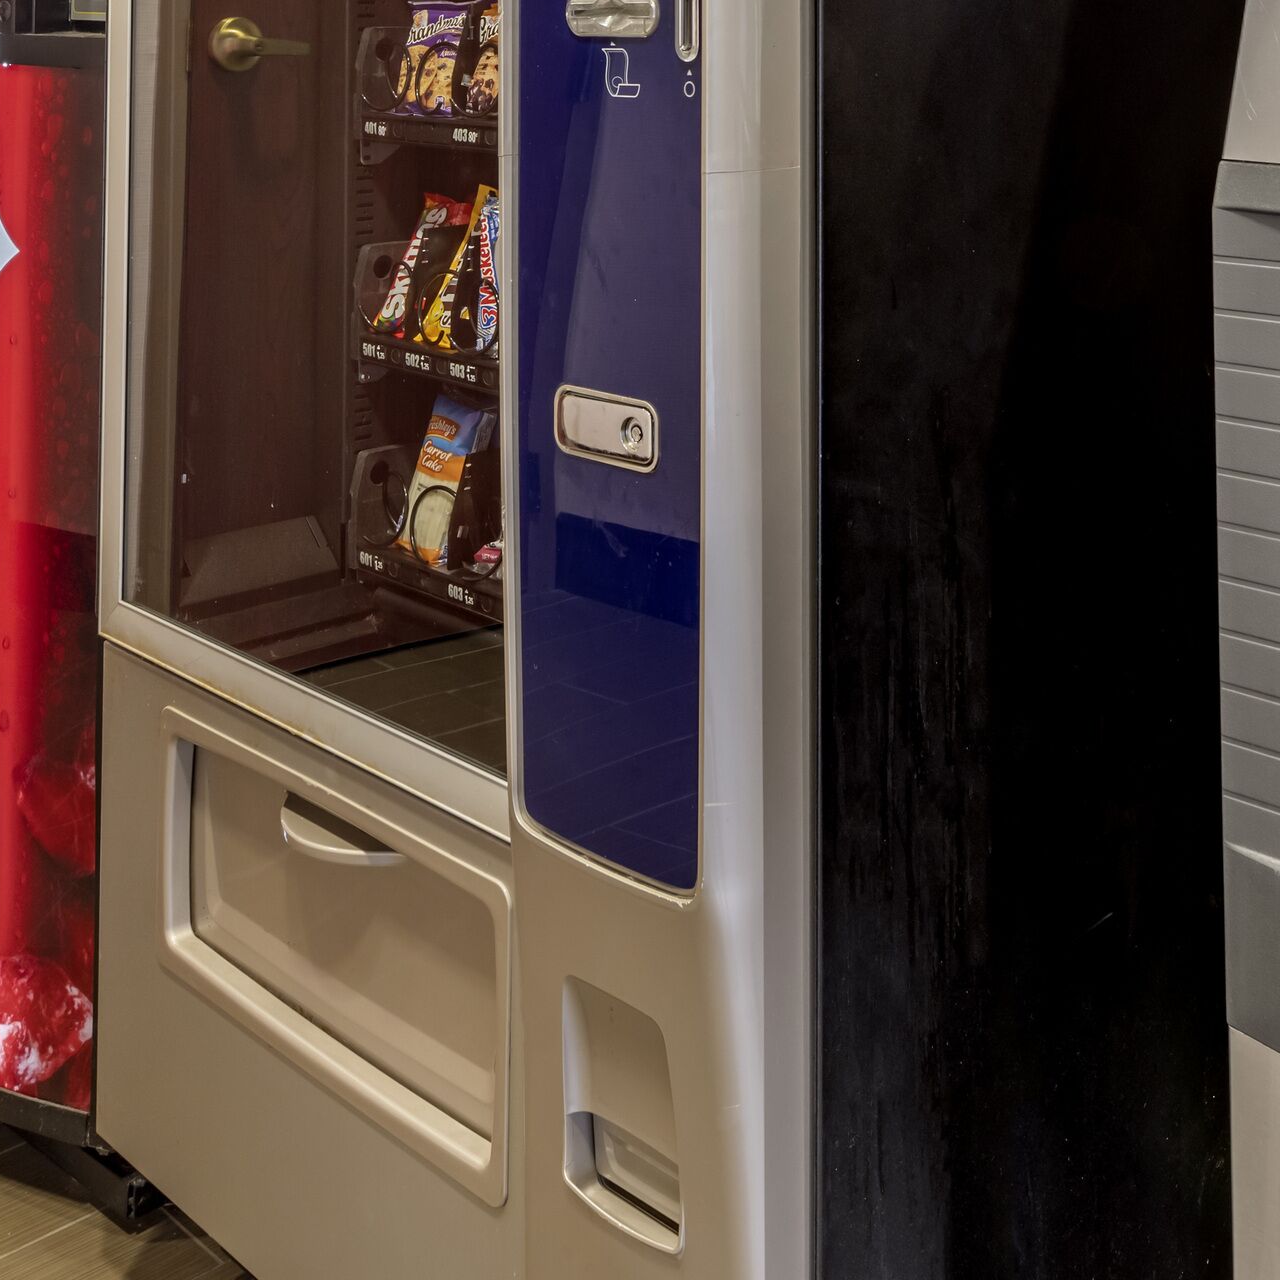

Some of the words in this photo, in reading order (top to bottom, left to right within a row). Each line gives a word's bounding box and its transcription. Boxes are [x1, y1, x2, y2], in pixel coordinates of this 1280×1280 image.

[364, 121, 377, 135] 401
[452, 128, 468, 142] 403
[481, 306, 497, 329] 3
[362, 342, 376, 358] 501
[405, 352, 420, 368] 502
[449, 362, 465, 379] 503
[429, 419, 456, 436] reshley's
[424, 440, 453, 462] Carrot
[422, 454, 443, 472] Cake
[360, 551, 373, 567] 601
[448, 583, 463, 601] 603
